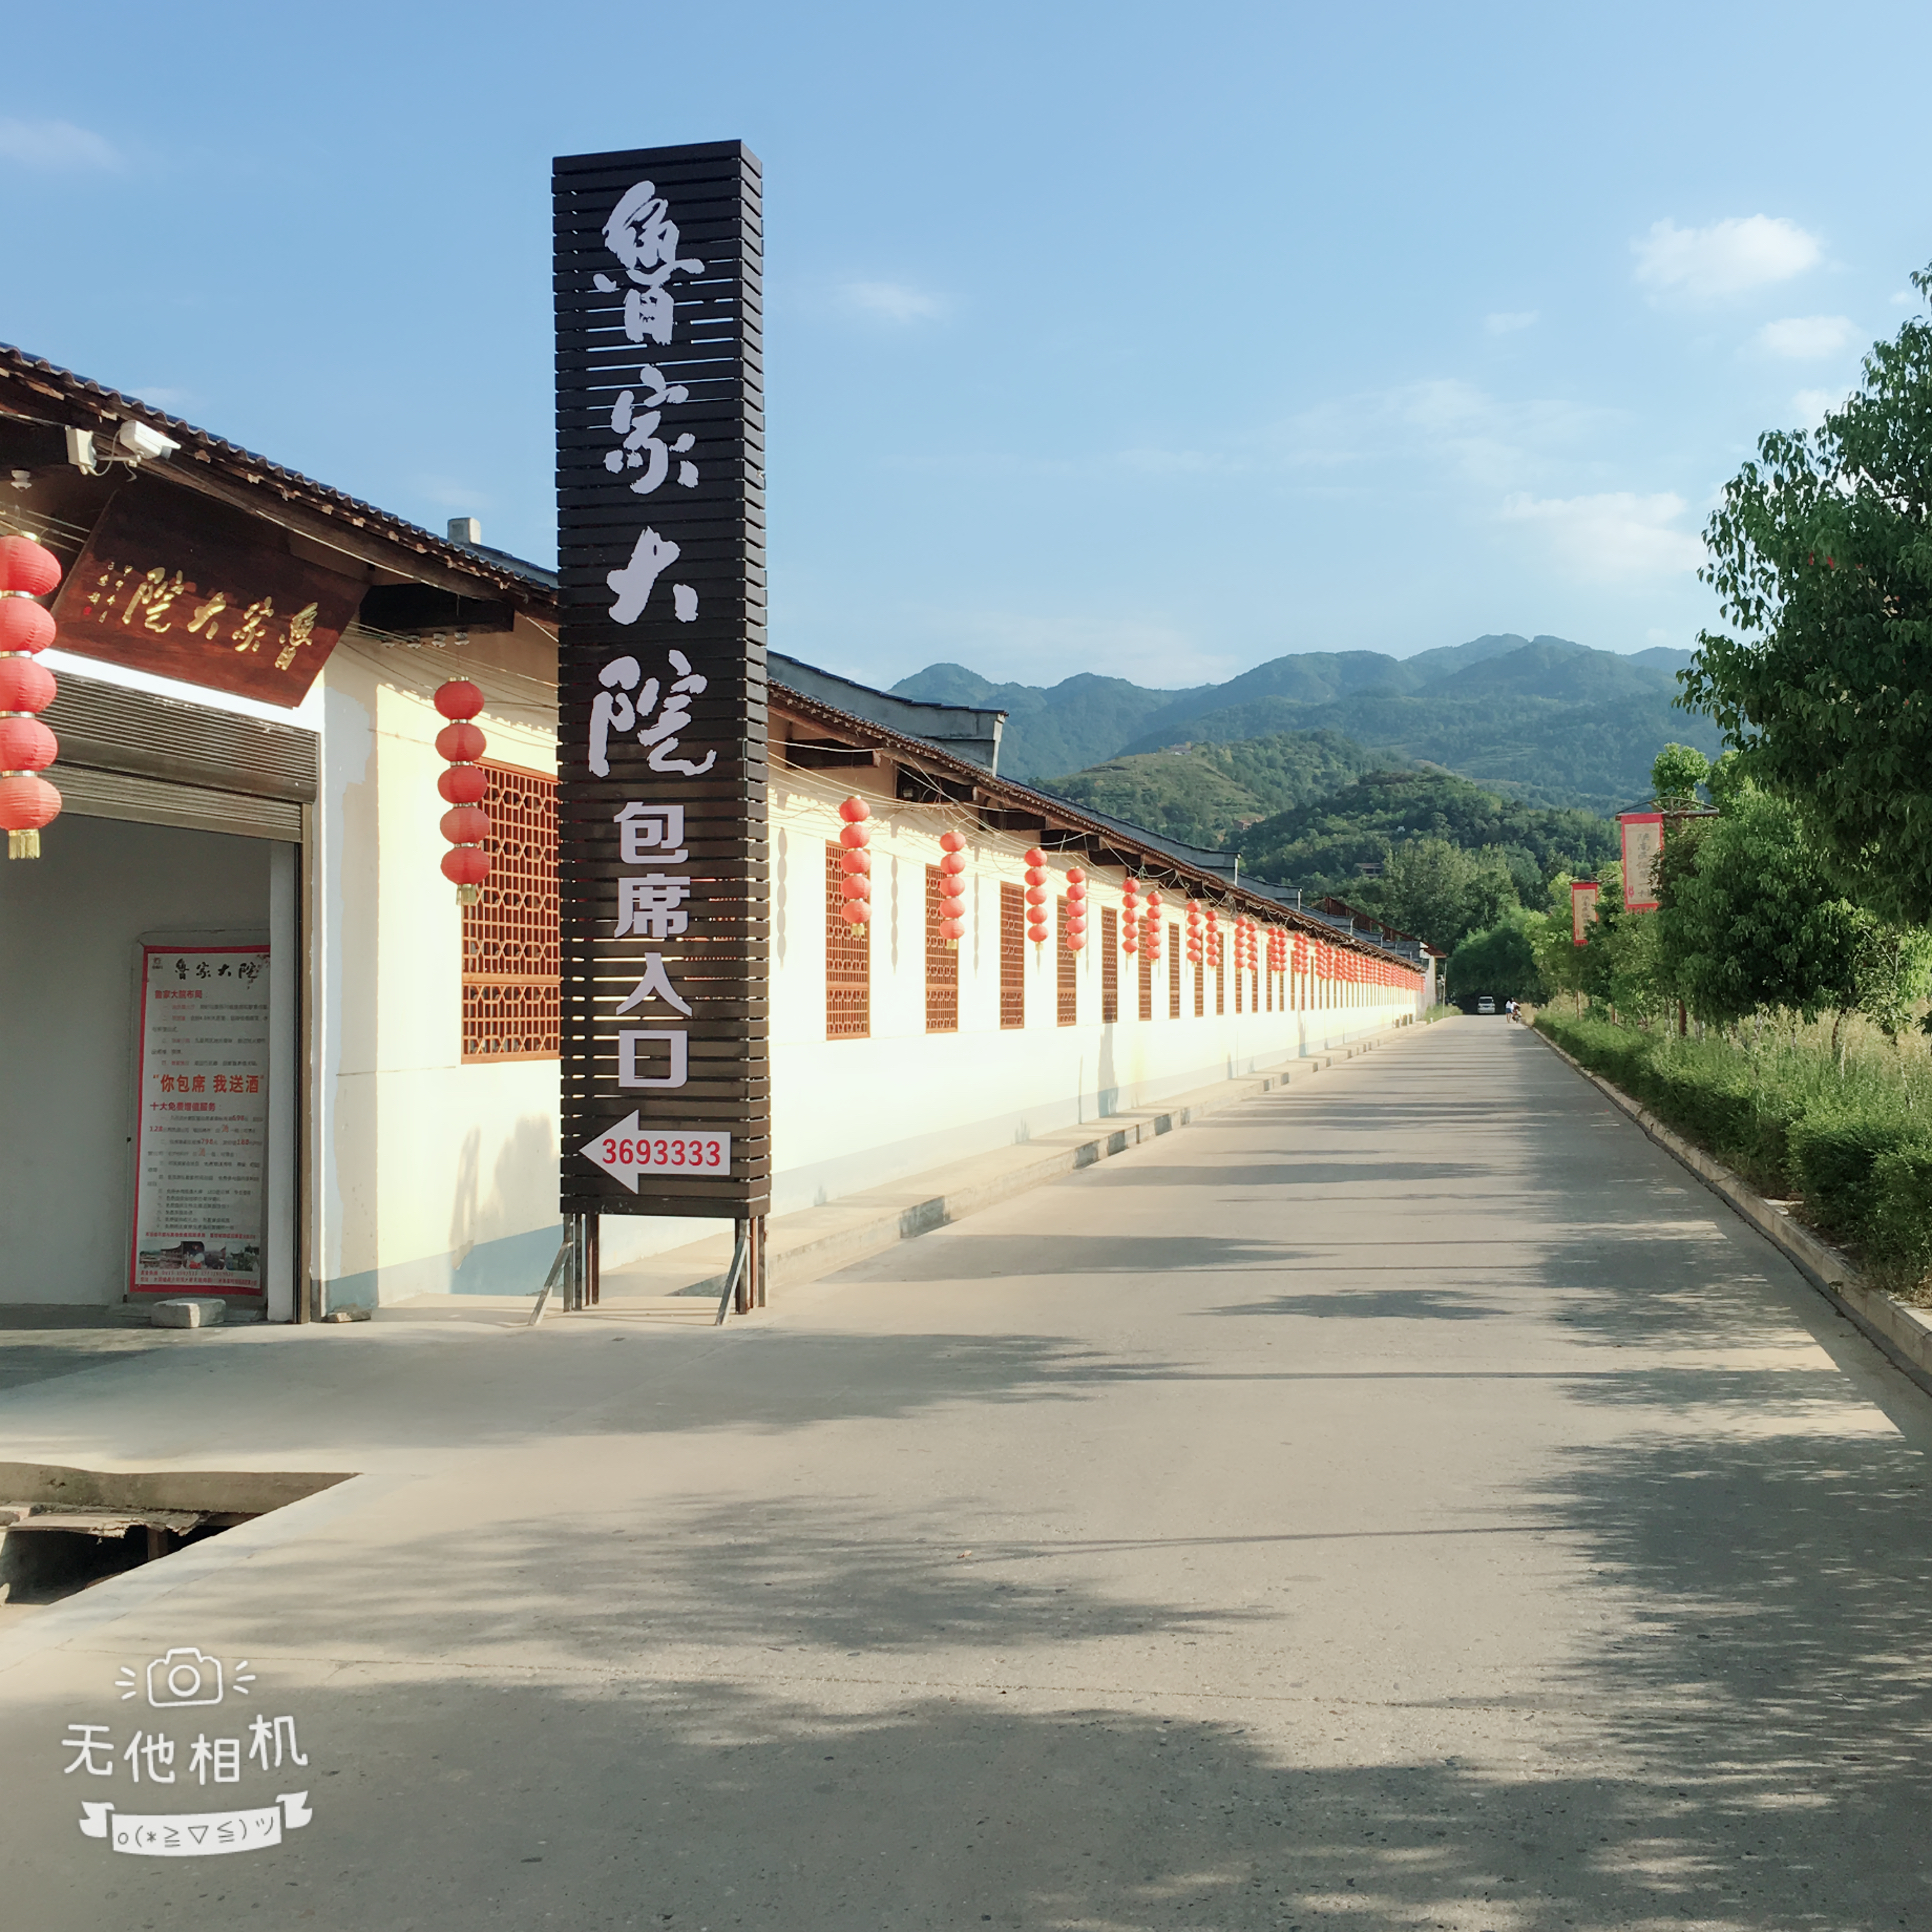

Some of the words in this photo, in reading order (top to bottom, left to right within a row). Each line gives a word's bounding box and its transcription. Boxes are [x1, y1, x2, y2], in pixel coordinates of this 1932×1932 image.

[613, 801, 693, 1089] 包席入口
[602, 1138, 721, 1167] 3693333
